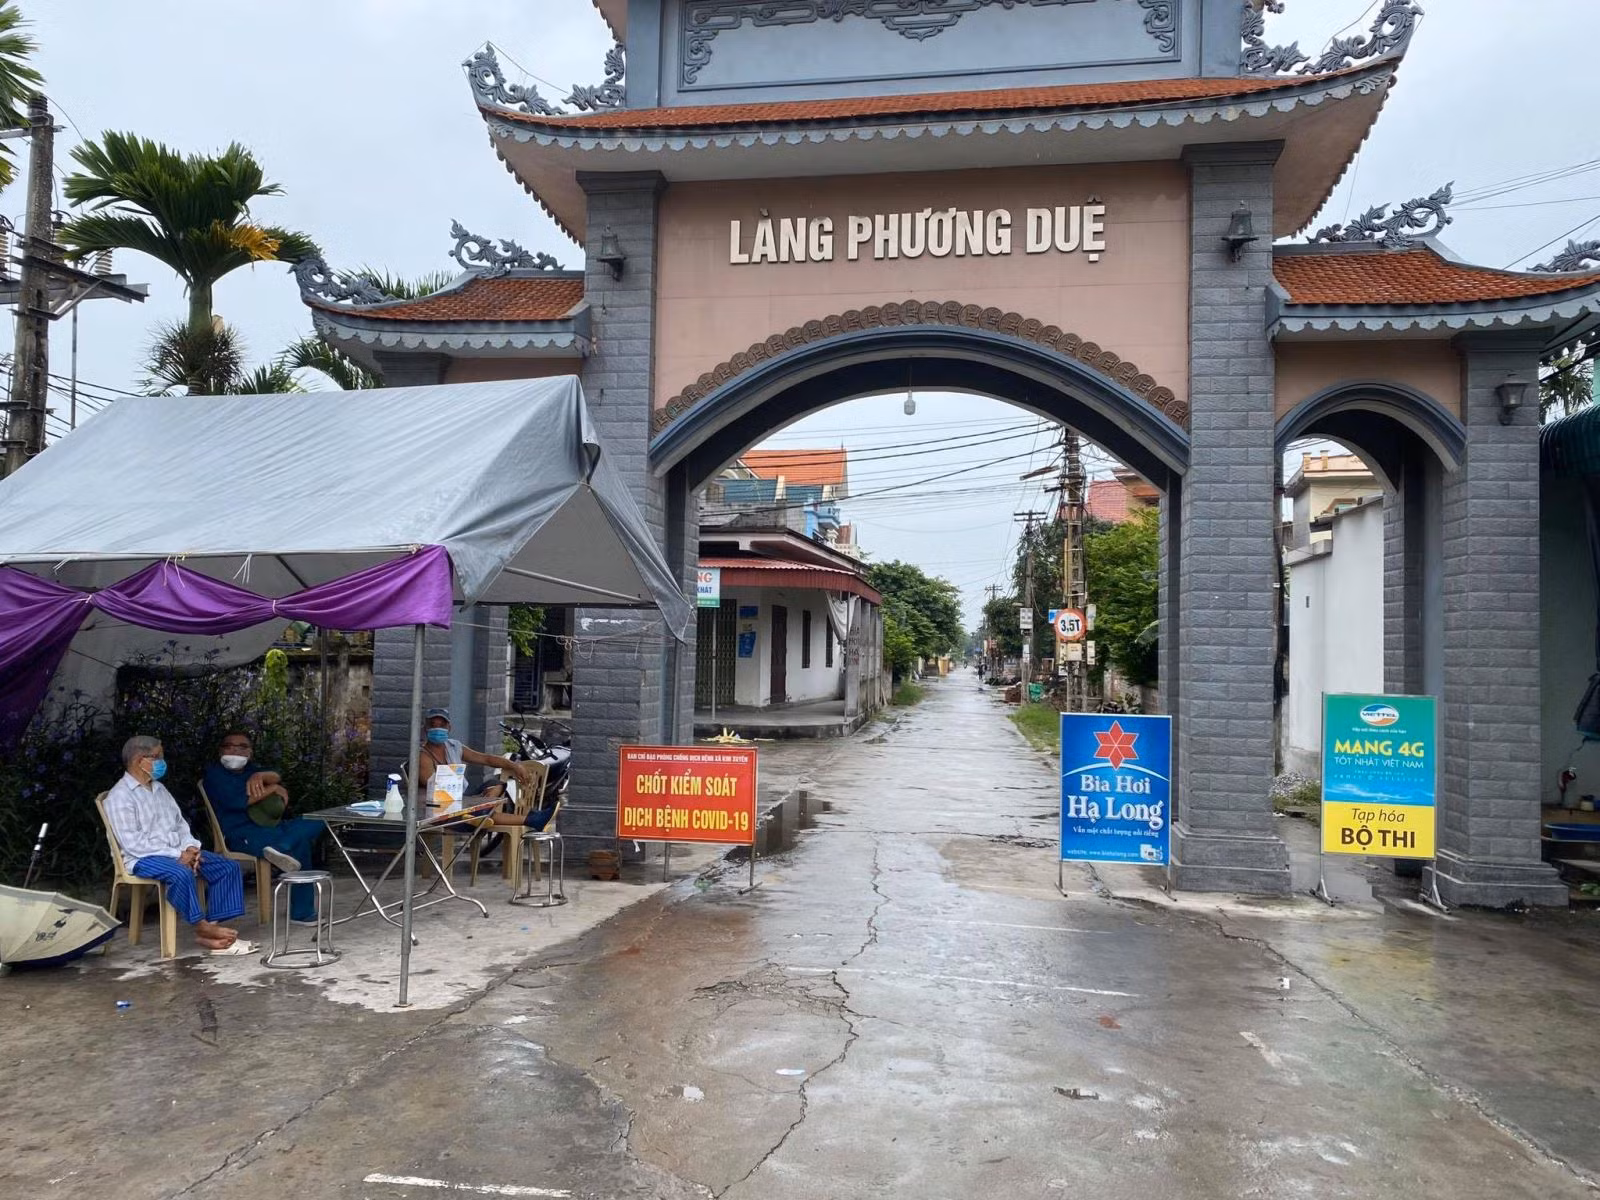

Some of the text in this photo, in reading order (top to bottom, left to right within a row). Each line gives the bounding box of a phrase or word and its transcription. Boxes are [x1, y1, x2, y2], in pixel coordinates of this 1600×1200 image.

[729, 193, 1106, 264] LÀNG PHƯƠNG DUỆ
[1334, 739, 1425, 758] MẠNG 4G
[1402, 760, 1424, 769] NAM
[636, 769, 737, 796] CHỐT KIỂM SOÁT
[1080, 774, 1151, 794] Bia Hơi
[624, 804, 749, 832] DỊCH BỆNH COVID-19
[1067, 795, 1164, 830] Hạ Long
[1352, 808, 1405, 824] Tạp hóa
[1341, 825, 1415, 851] BỘ THI
